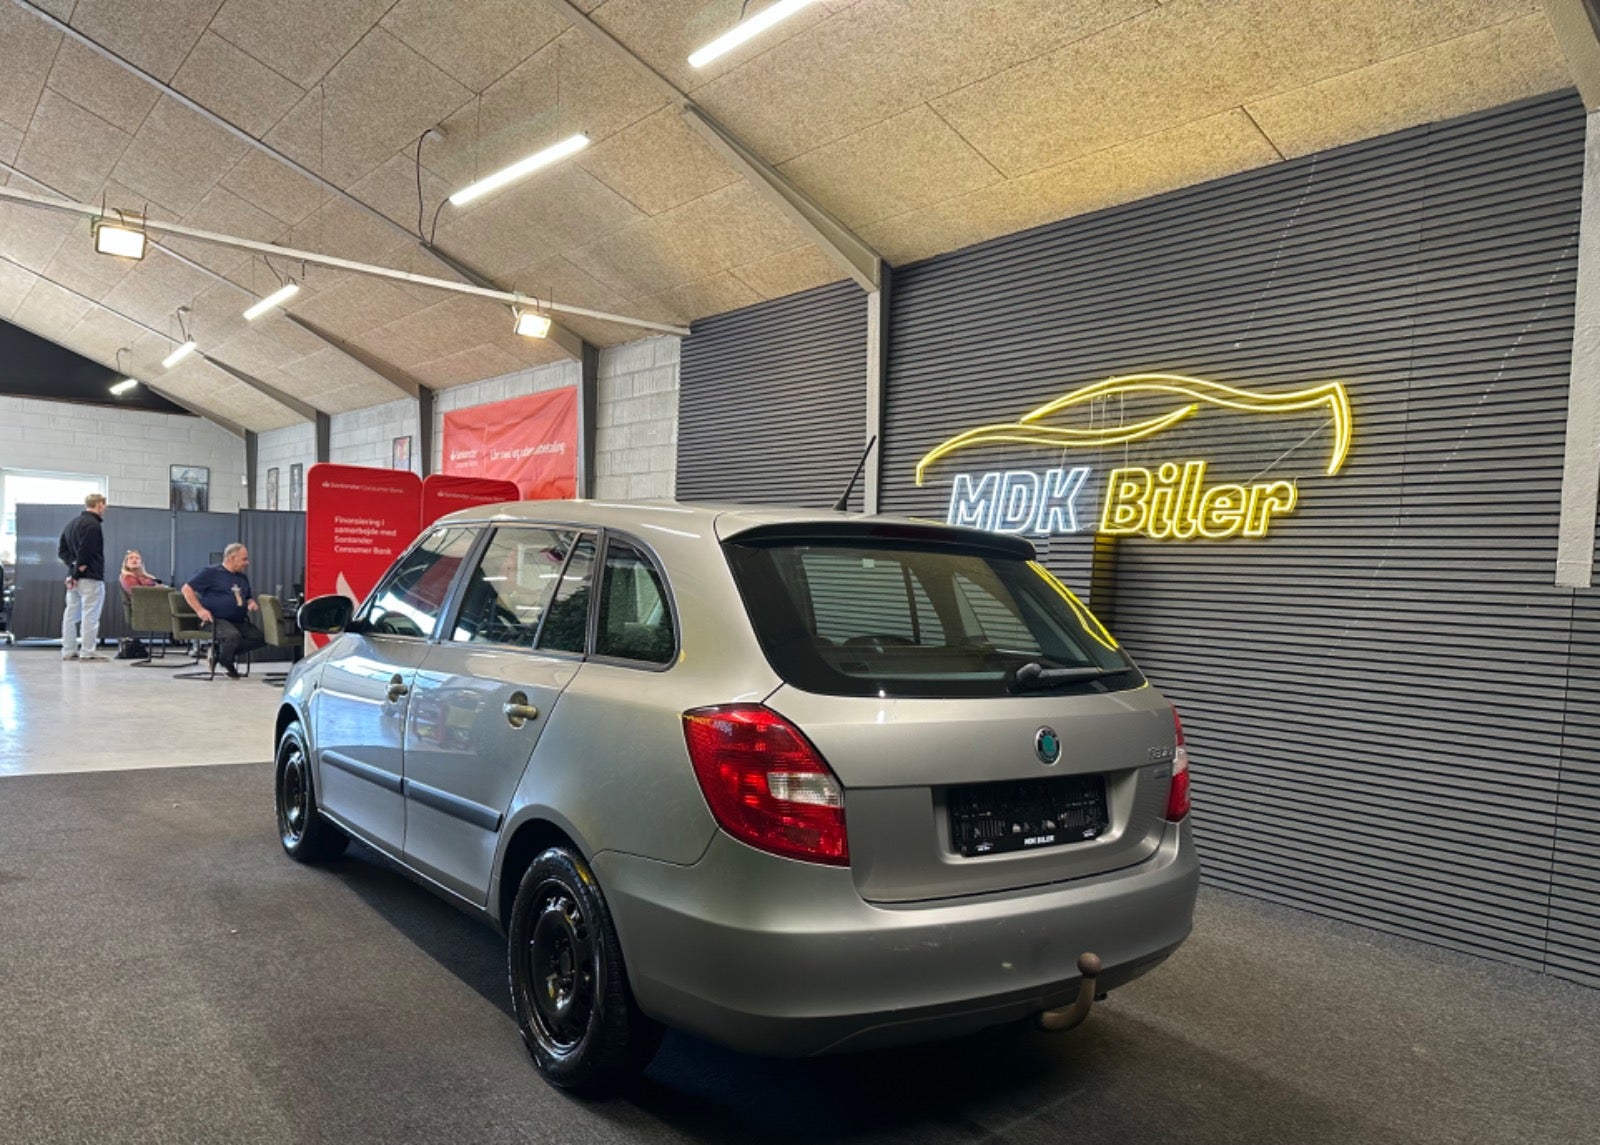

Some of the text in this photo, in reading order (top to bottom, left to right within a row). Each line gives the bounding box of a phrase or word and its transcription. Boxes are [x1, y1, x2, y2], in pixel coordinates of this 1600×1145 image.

[946, 460, 1298, 539] MDK Biler
[334, 526, 397, 537] samarbejde med
[334, 535, 374, 545] Santander
[334, 544, 392, 556] Consumer Bank
